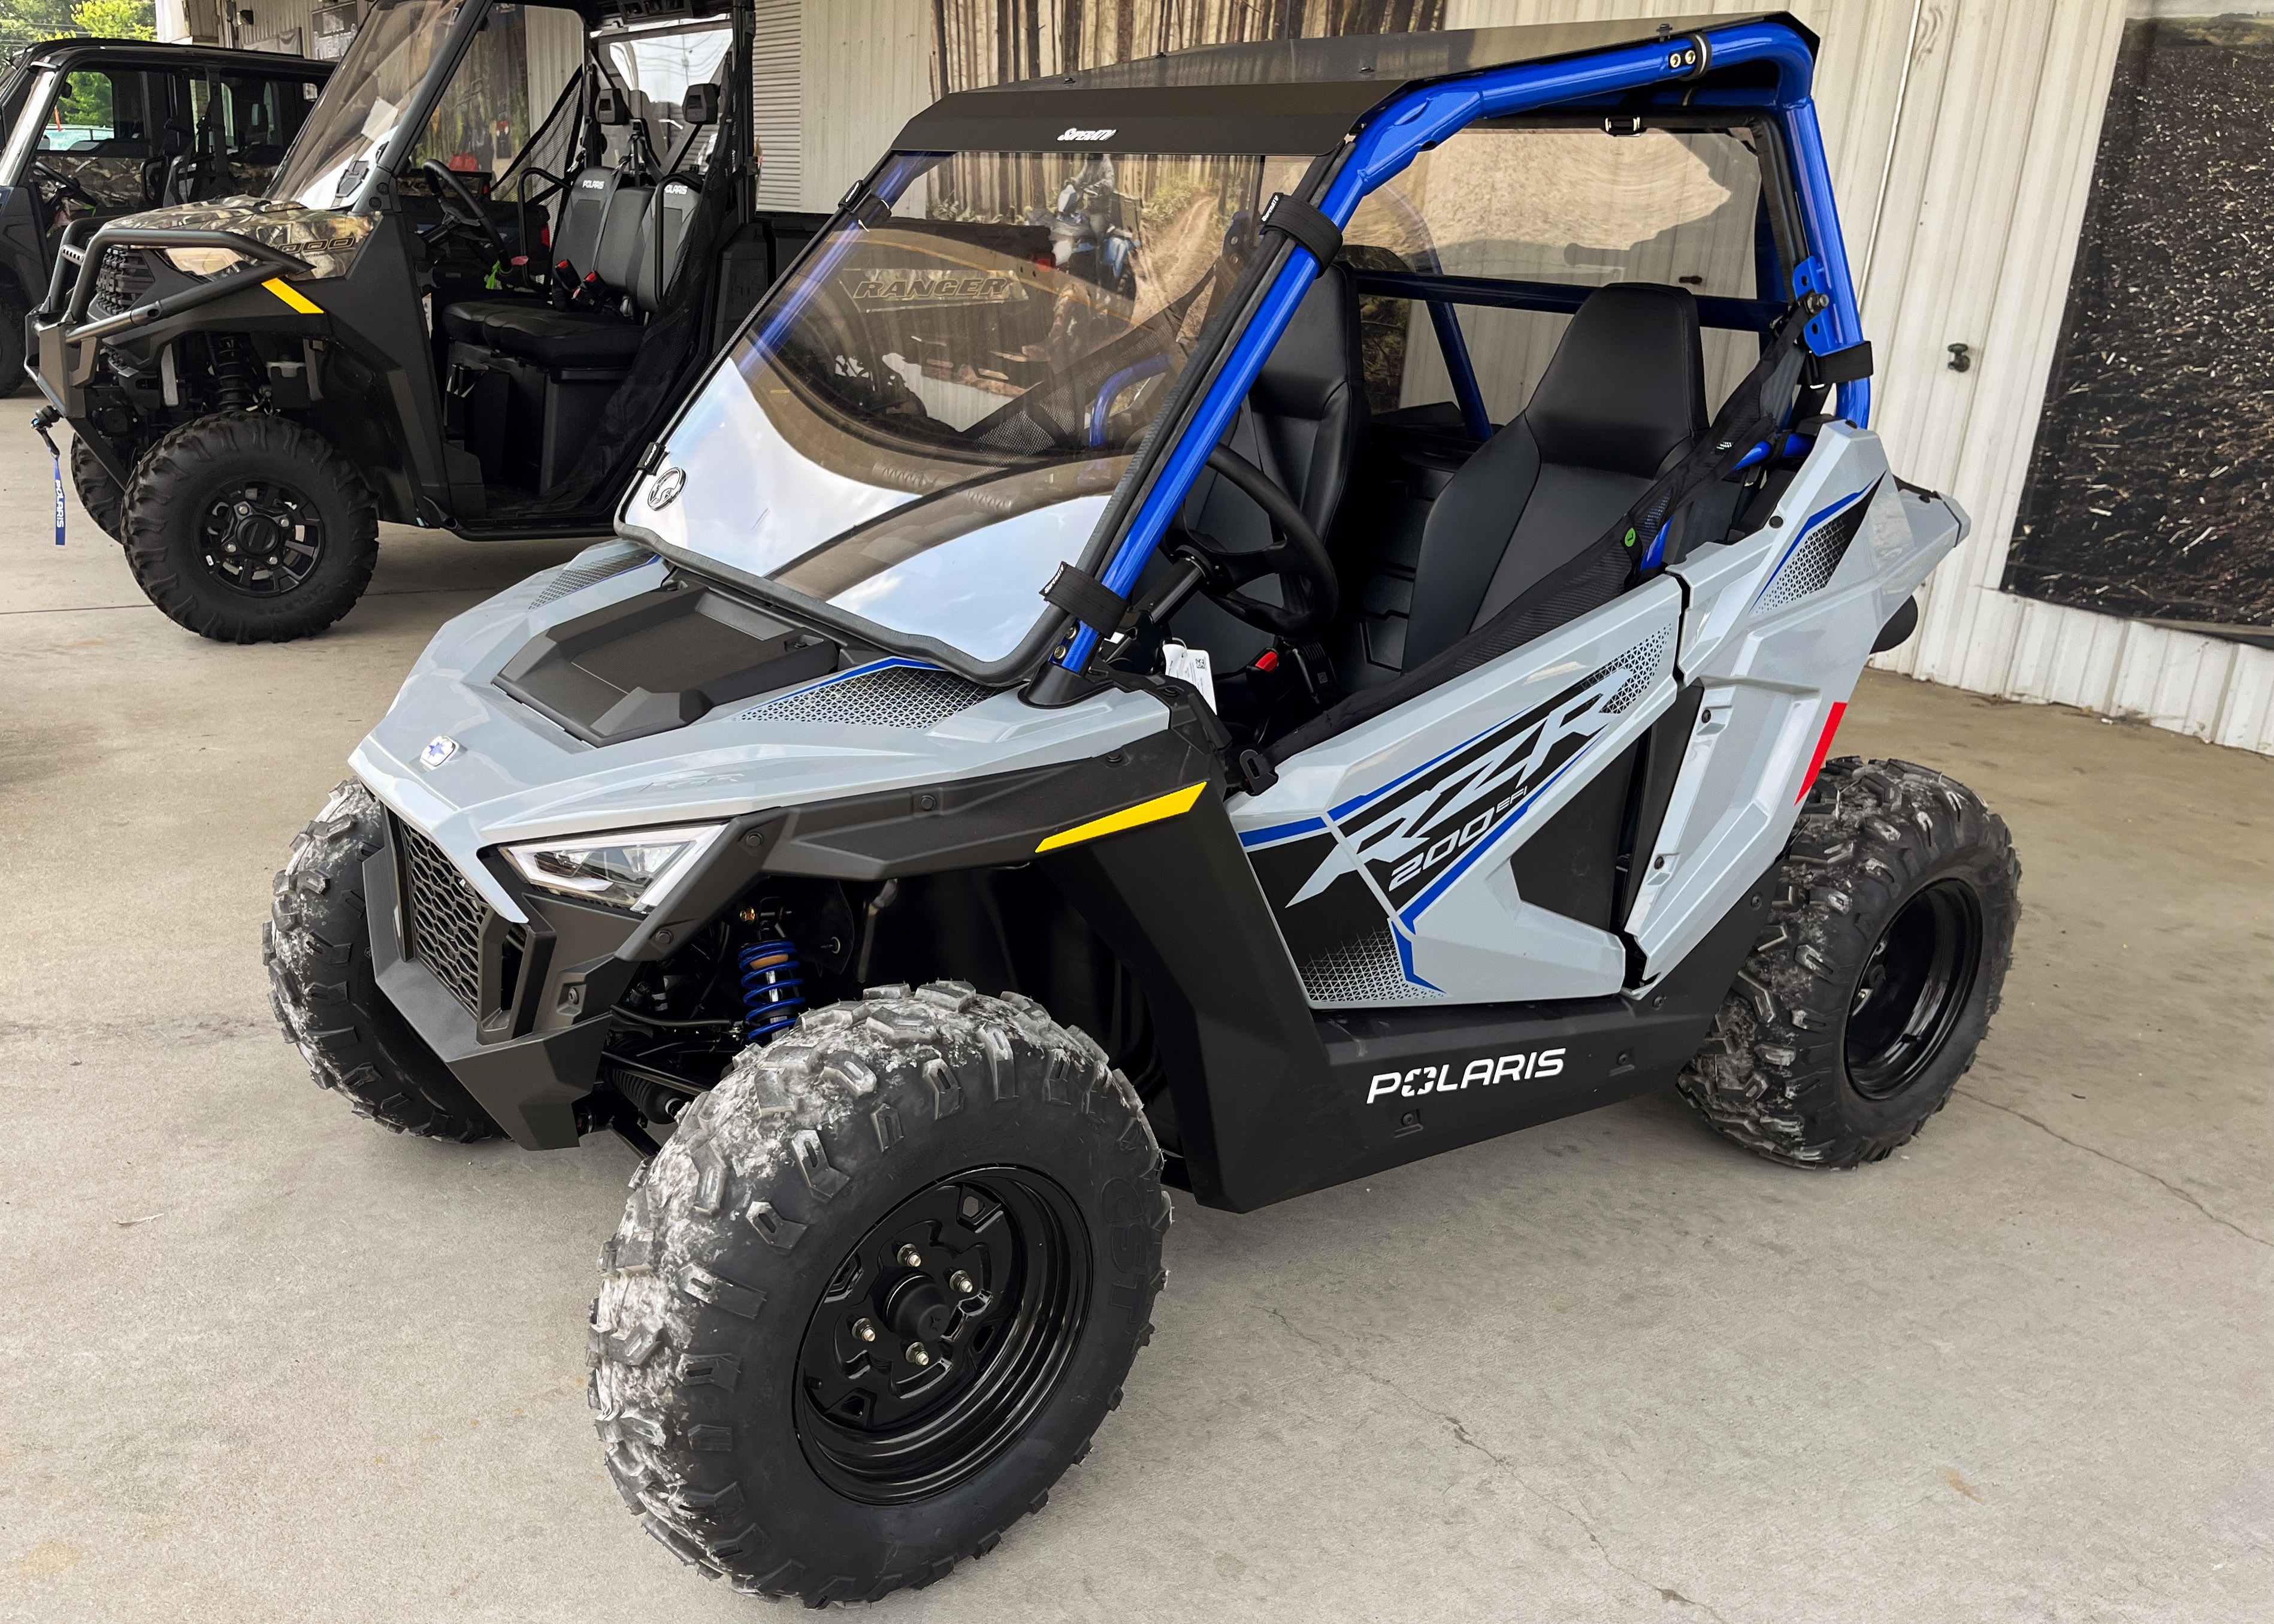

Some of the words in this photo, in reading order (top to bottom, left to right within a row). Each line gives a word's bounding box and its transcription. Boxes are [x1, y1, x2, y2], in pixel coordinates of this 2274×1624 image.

[582, 180, 605, 190] POLARIS
[664, 184, 688, 195] OLARIS
[271, 237, 356, 255] 000
[852, 277, 1008, 299] RANGER
[55, 479, 64, 528] POLARIS
[1285, 668, 1634, 909] RZR
[1388, 806, 1495, 892] 200
[1496, 786, 1528, 814] EFI
[1366, 1048, 1567, 1104] POLARIS
